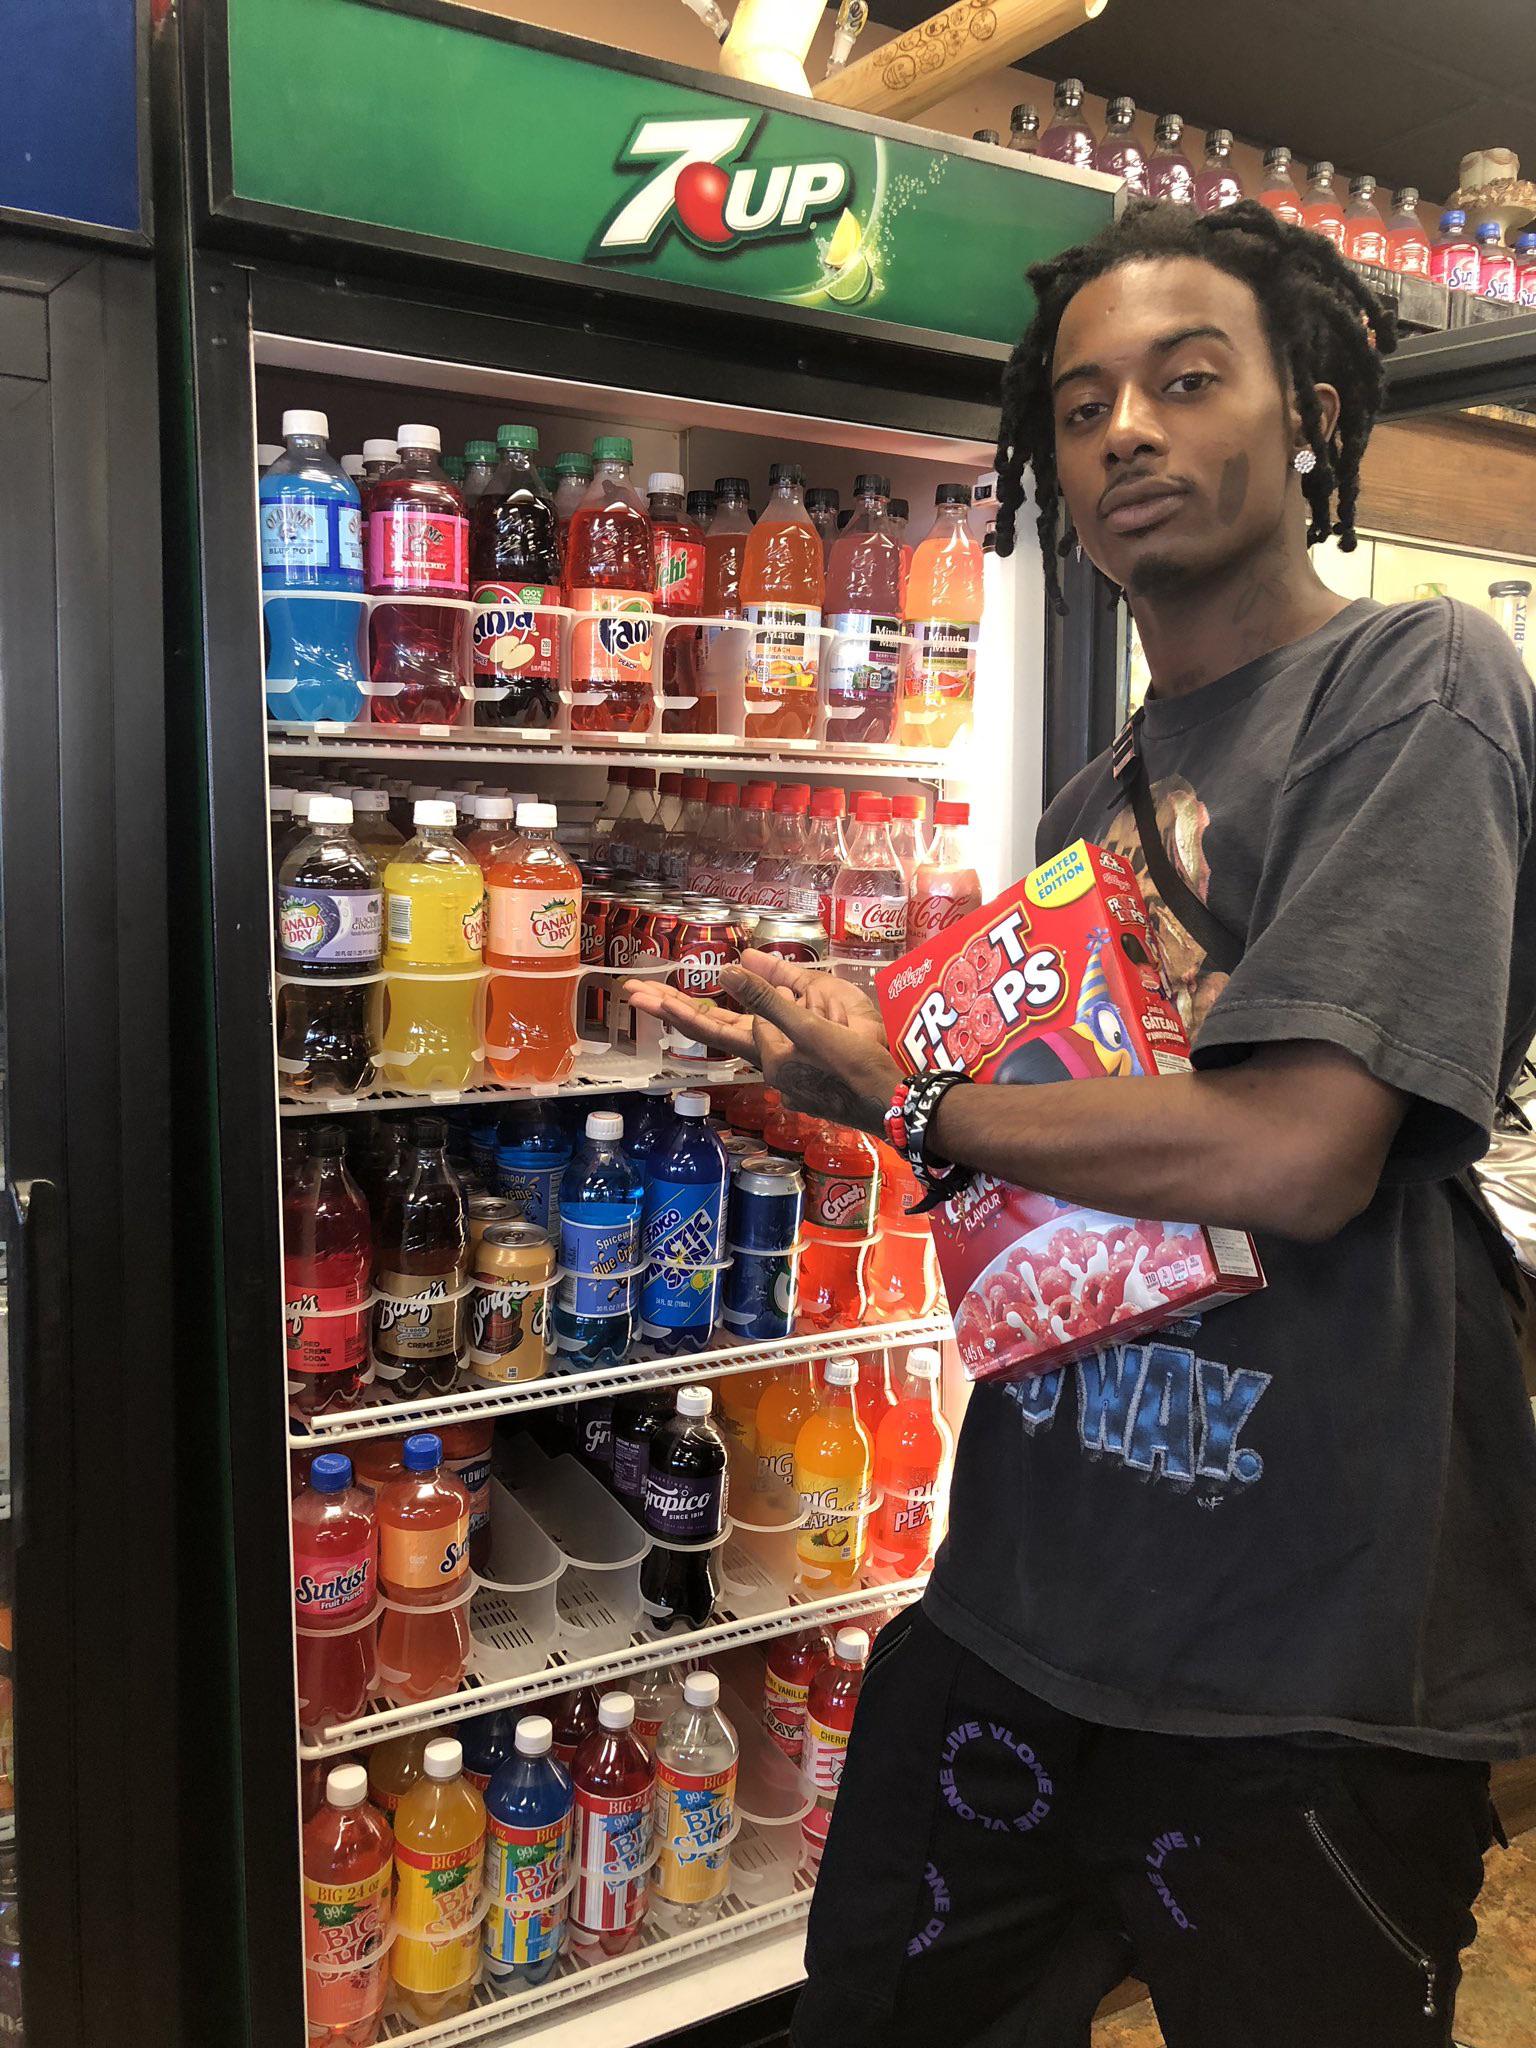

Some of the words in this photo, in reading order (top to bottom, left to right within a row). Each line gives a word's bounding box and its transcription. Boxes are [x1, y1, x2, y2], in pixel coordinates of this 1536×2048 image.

[292, 547, 314, 555] POP
[522, 589, 541, 597] 100%
[928, 632, 967, 643] Minute
[618, 657, 638, 670] PEACH
[1035, 851, 1078, 887] LIMITED
[1038, 862, 1085, 900] EDITION
[289, 928, 313, 944] DRY
[531, 911, 578, 937] CANADA
[549, 925, 572, 942] DRY
[699, 950, 726, 967] Dr
[888, 958, 933, 1000] Kellogg's
[821, 1183, 867, 1221] Crush
[964, 1192, 1002, 1232] FLAVOUR
[644, 1208, 682, 1247] FAYGO
[592, 1257, 617, 1278] Blue
[303, 1340, 320, 1348] RED
[407, 1341, 435, 1349] CREME
[799, 1487, 839, 1513] BIG
[894, 1503, 936, 1533] PEA
[295, 1557, 371, 1604] Sunkist
[320, 1598, 341, 1611] Fruit
[341, 1586, 365, 1604] Punch
[777, 1685, 808, 1700] VANILLA
[820, 1730, 848, 1746] CHERR
[941, 1721, 983, 1764] LIVE
[987, 1721, 1053, 1796] VLONE
[704, 1775, 725, 1790] BIG
[608, 1799, 632, 1815] BIG
[939, 1768, 1011, 1833] VLONE
[683, 1797, 732, 1835] BIG
[1012, 1798, 1051, 1832] DIE
[431, 1853, 457, 1870] BIG
[1145, 1831, 1188, 1870] LIVE
[318, 1886, 343, 1903] BIG
[347, 1883, 365, 1901] 24
[321, 1908, 379, 1952] BIG
[905, 1917, 946, 1957] DIE
